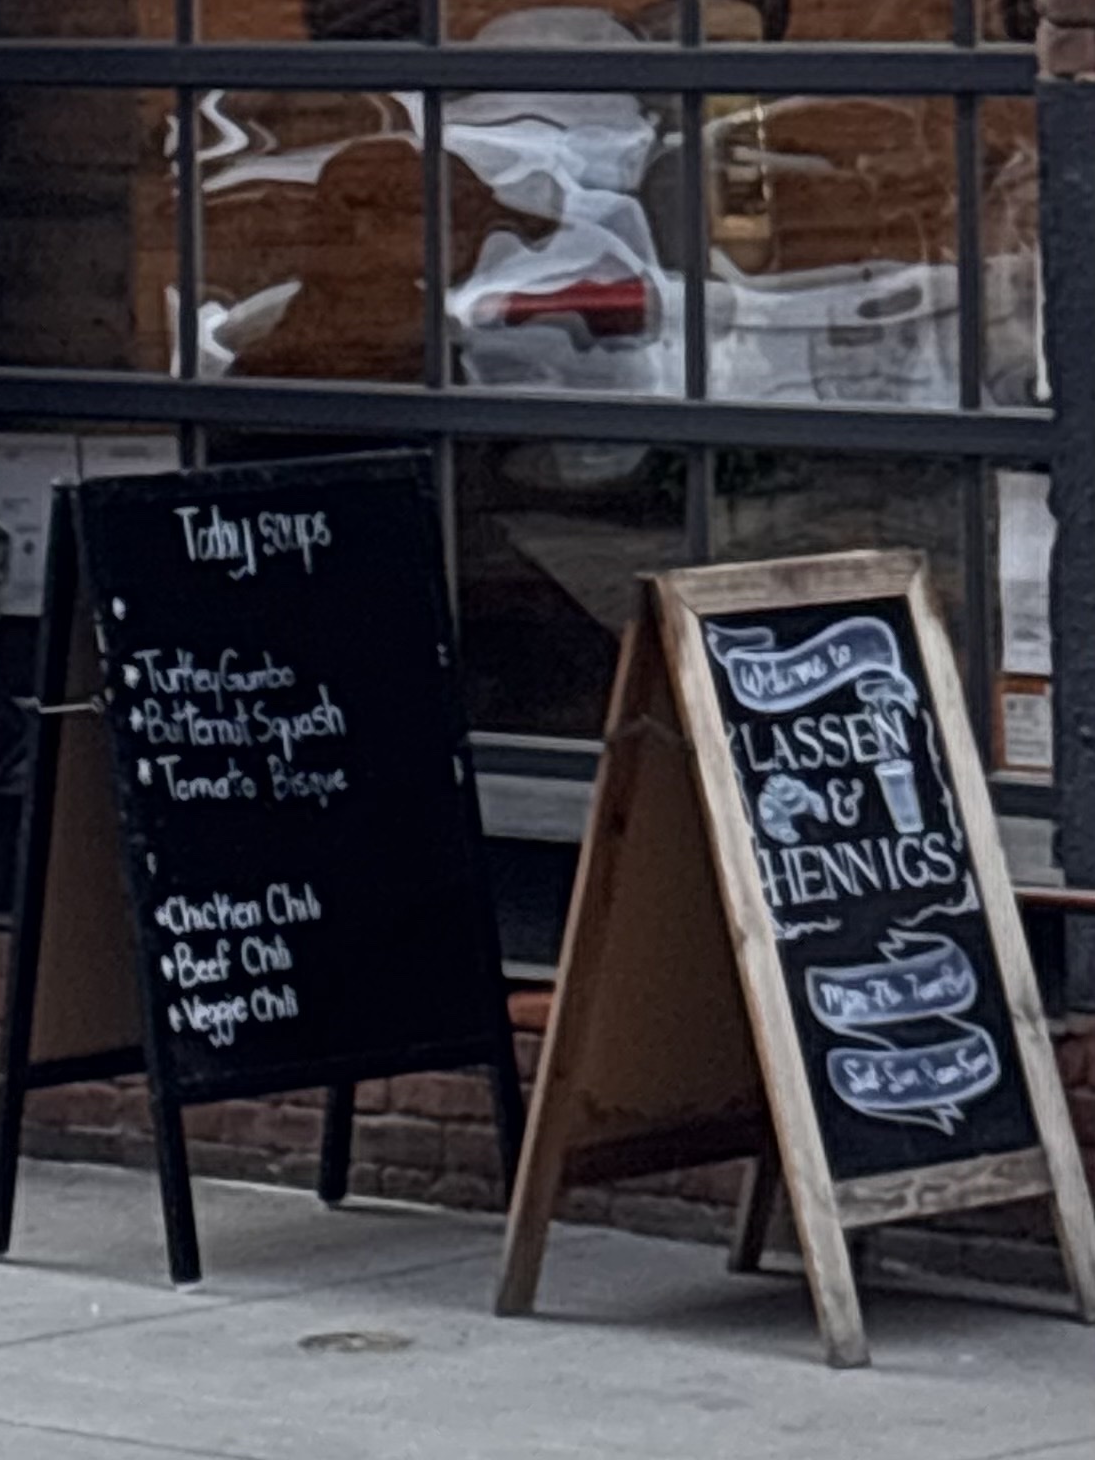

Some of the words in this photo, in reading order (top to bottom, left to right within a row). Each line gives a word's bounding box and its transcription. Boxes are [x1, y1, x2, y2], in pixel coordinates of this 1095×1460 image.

[252, 683, 347, 762] Squash
[741, 704, 912, 771] LASSEN
[155, 754, 257, 801] Tomato
[827, 777, 864, 827] &
[163, 893, 261, 935] Chicken
[265, 882, 322, 926] Chili
[173, 939, 231, 989] Beef
[241, 934, 292, 976] Chili
[181, 992, 249, 1048] Veggie
[250, 984, 299, 1022] Chili
